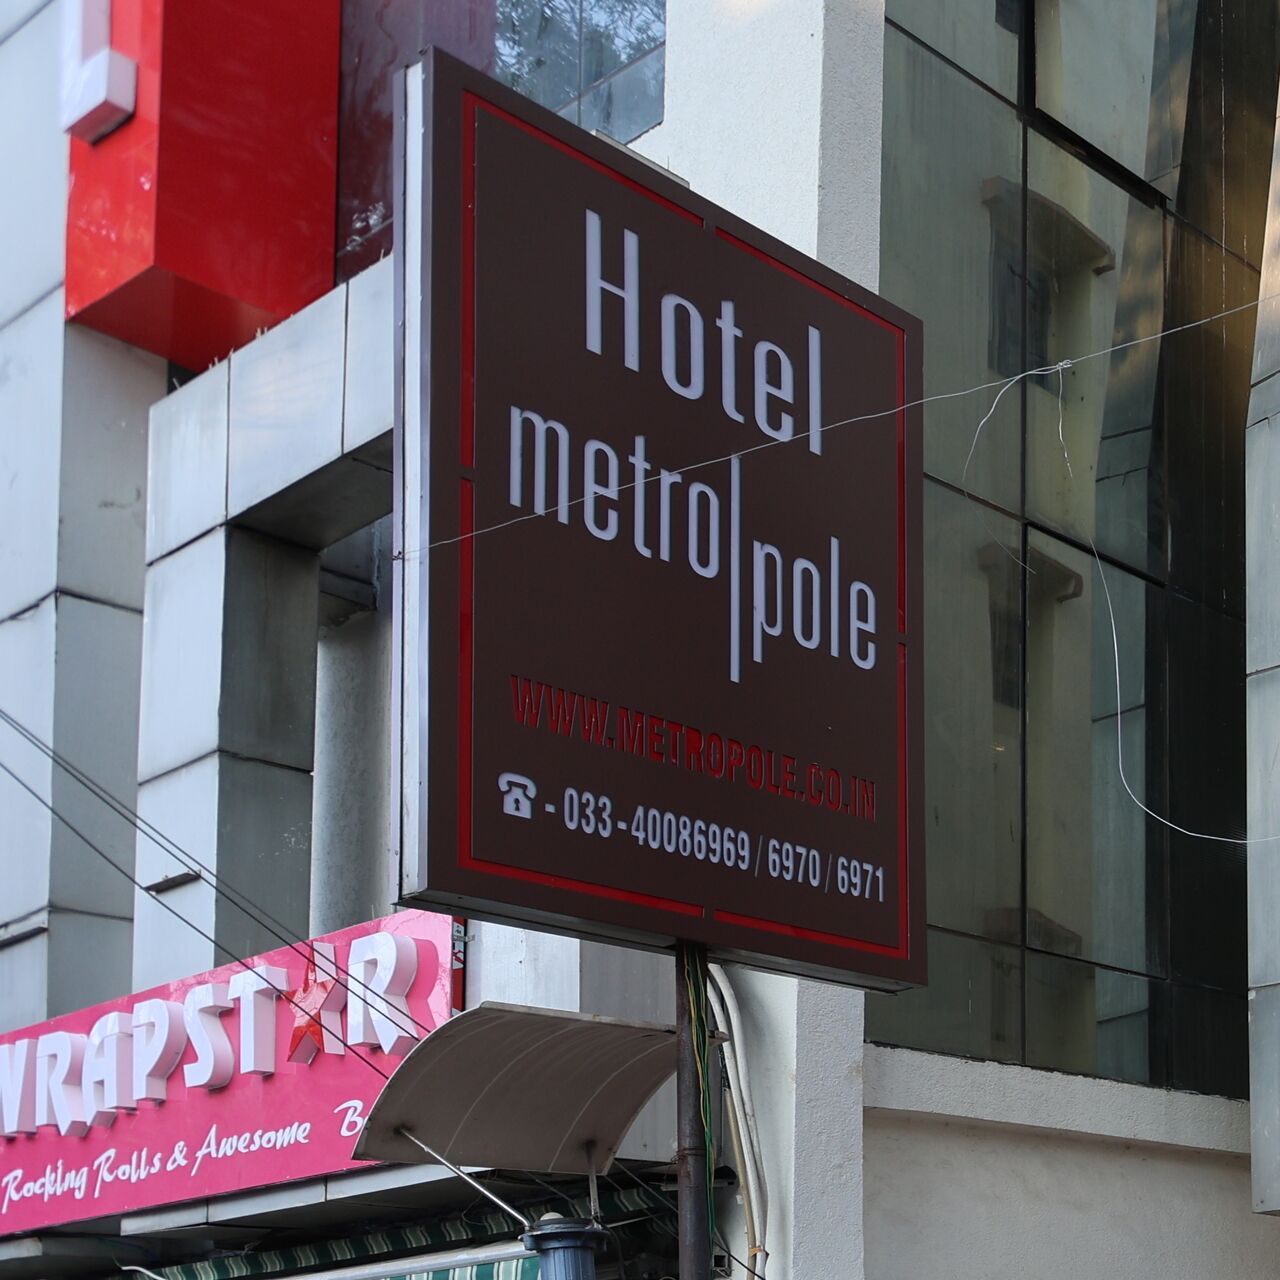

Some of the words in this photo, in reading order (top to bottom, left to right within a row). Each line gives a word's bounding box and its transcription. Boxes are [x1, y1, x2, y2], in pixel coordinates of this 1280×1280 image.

[585, 209, 822, 456] Hotel
[510, 674, 877, 823] WWW.METROPOLE.CO.IN
[1, 1160, 89, 1215] Rocking
[93, 1147, 163, 1199] Rolls
[166, 1140, 188, 1172] &
[191, 1121, 312, 1177] Awesome
